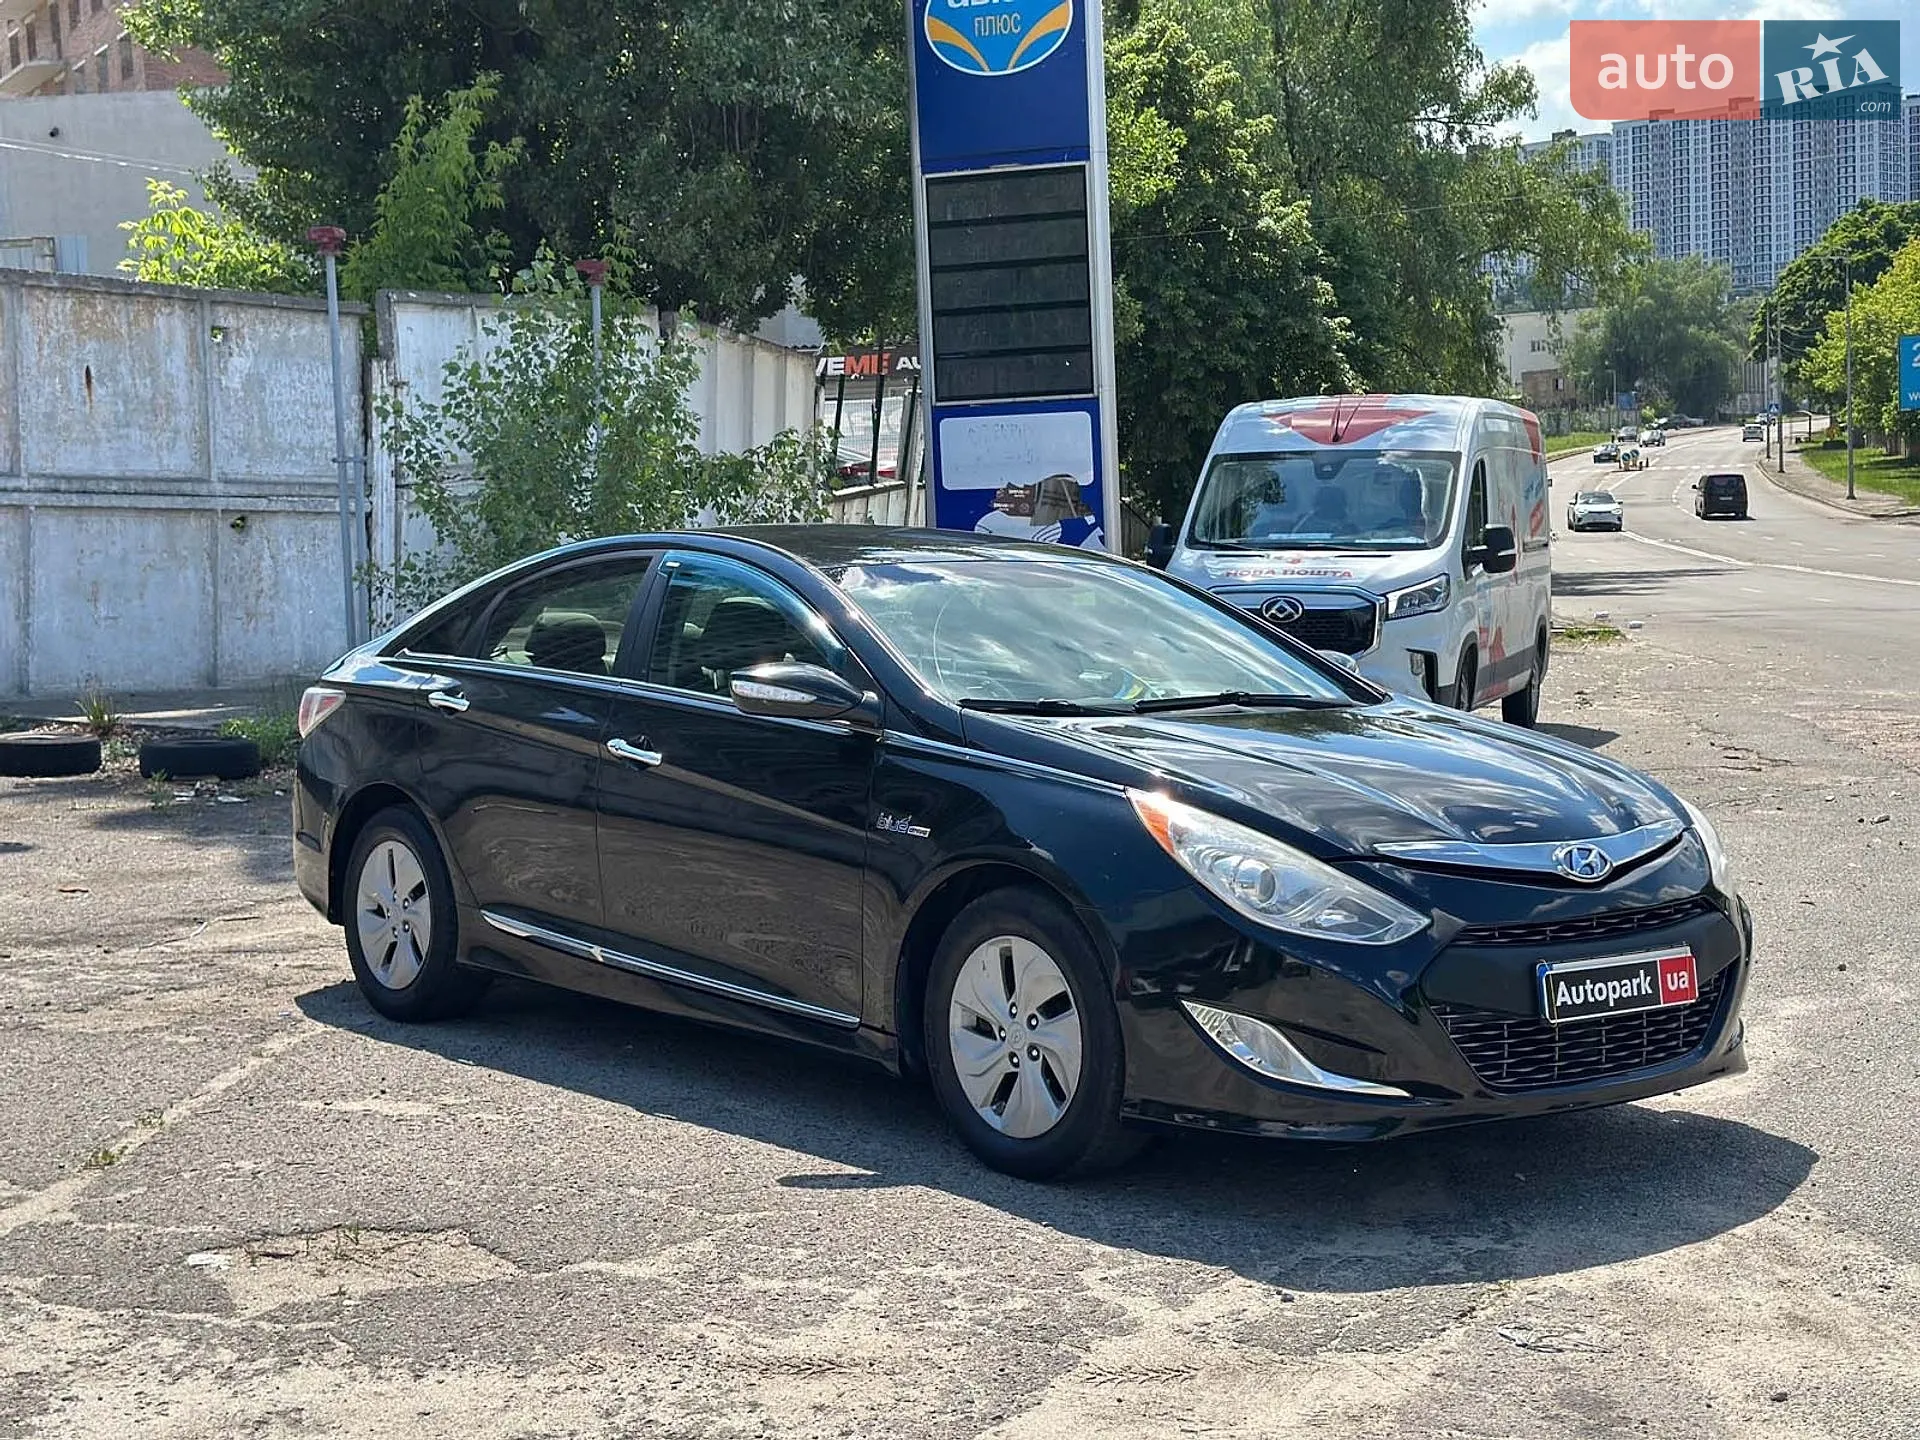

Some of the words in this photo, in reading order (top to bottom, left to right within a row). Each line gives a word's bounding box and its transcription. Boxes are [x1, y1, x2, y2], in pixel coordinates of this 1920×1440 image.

[974, 12, 1021, 37] ПЛЮС
[1282, 569, 1353, 578] ПОШТА
[1556, 969, 1653, 1007] Autopark
[1666, 970, 1690, 992] ua
